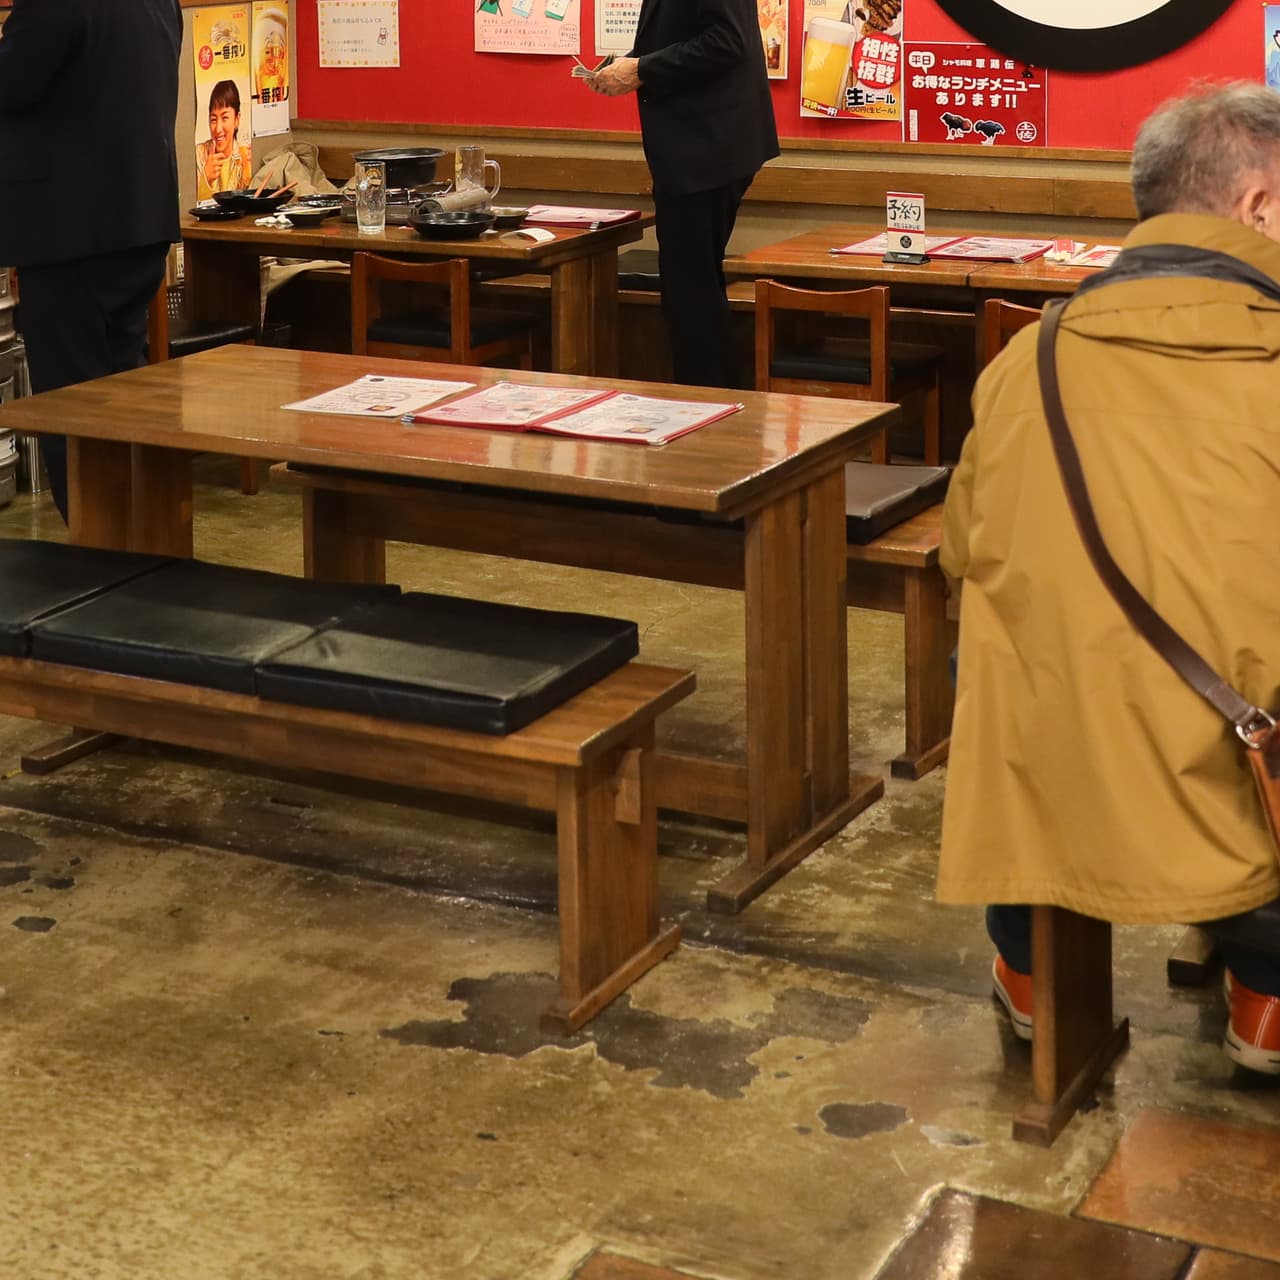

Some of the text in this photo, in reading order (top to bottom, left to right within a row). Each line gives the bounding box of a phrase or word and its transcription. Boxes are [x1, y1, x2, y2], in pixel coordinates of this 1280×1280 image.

[215, 44, 246, 60] 一番搾り
[862, 37, 900, 63] 相性
[911, 53, 934, 65] 平日
[857, 61, 896, 85] 抜群
[912, 75, 1041, 93] お得なランチメニュー
[251, 86, 289, 103] 一番搾り
[847, 87, 896, 106] 生ビール
[935, 91, 1017, 108] あります!!
[887, 199, 922, 222] 予約
